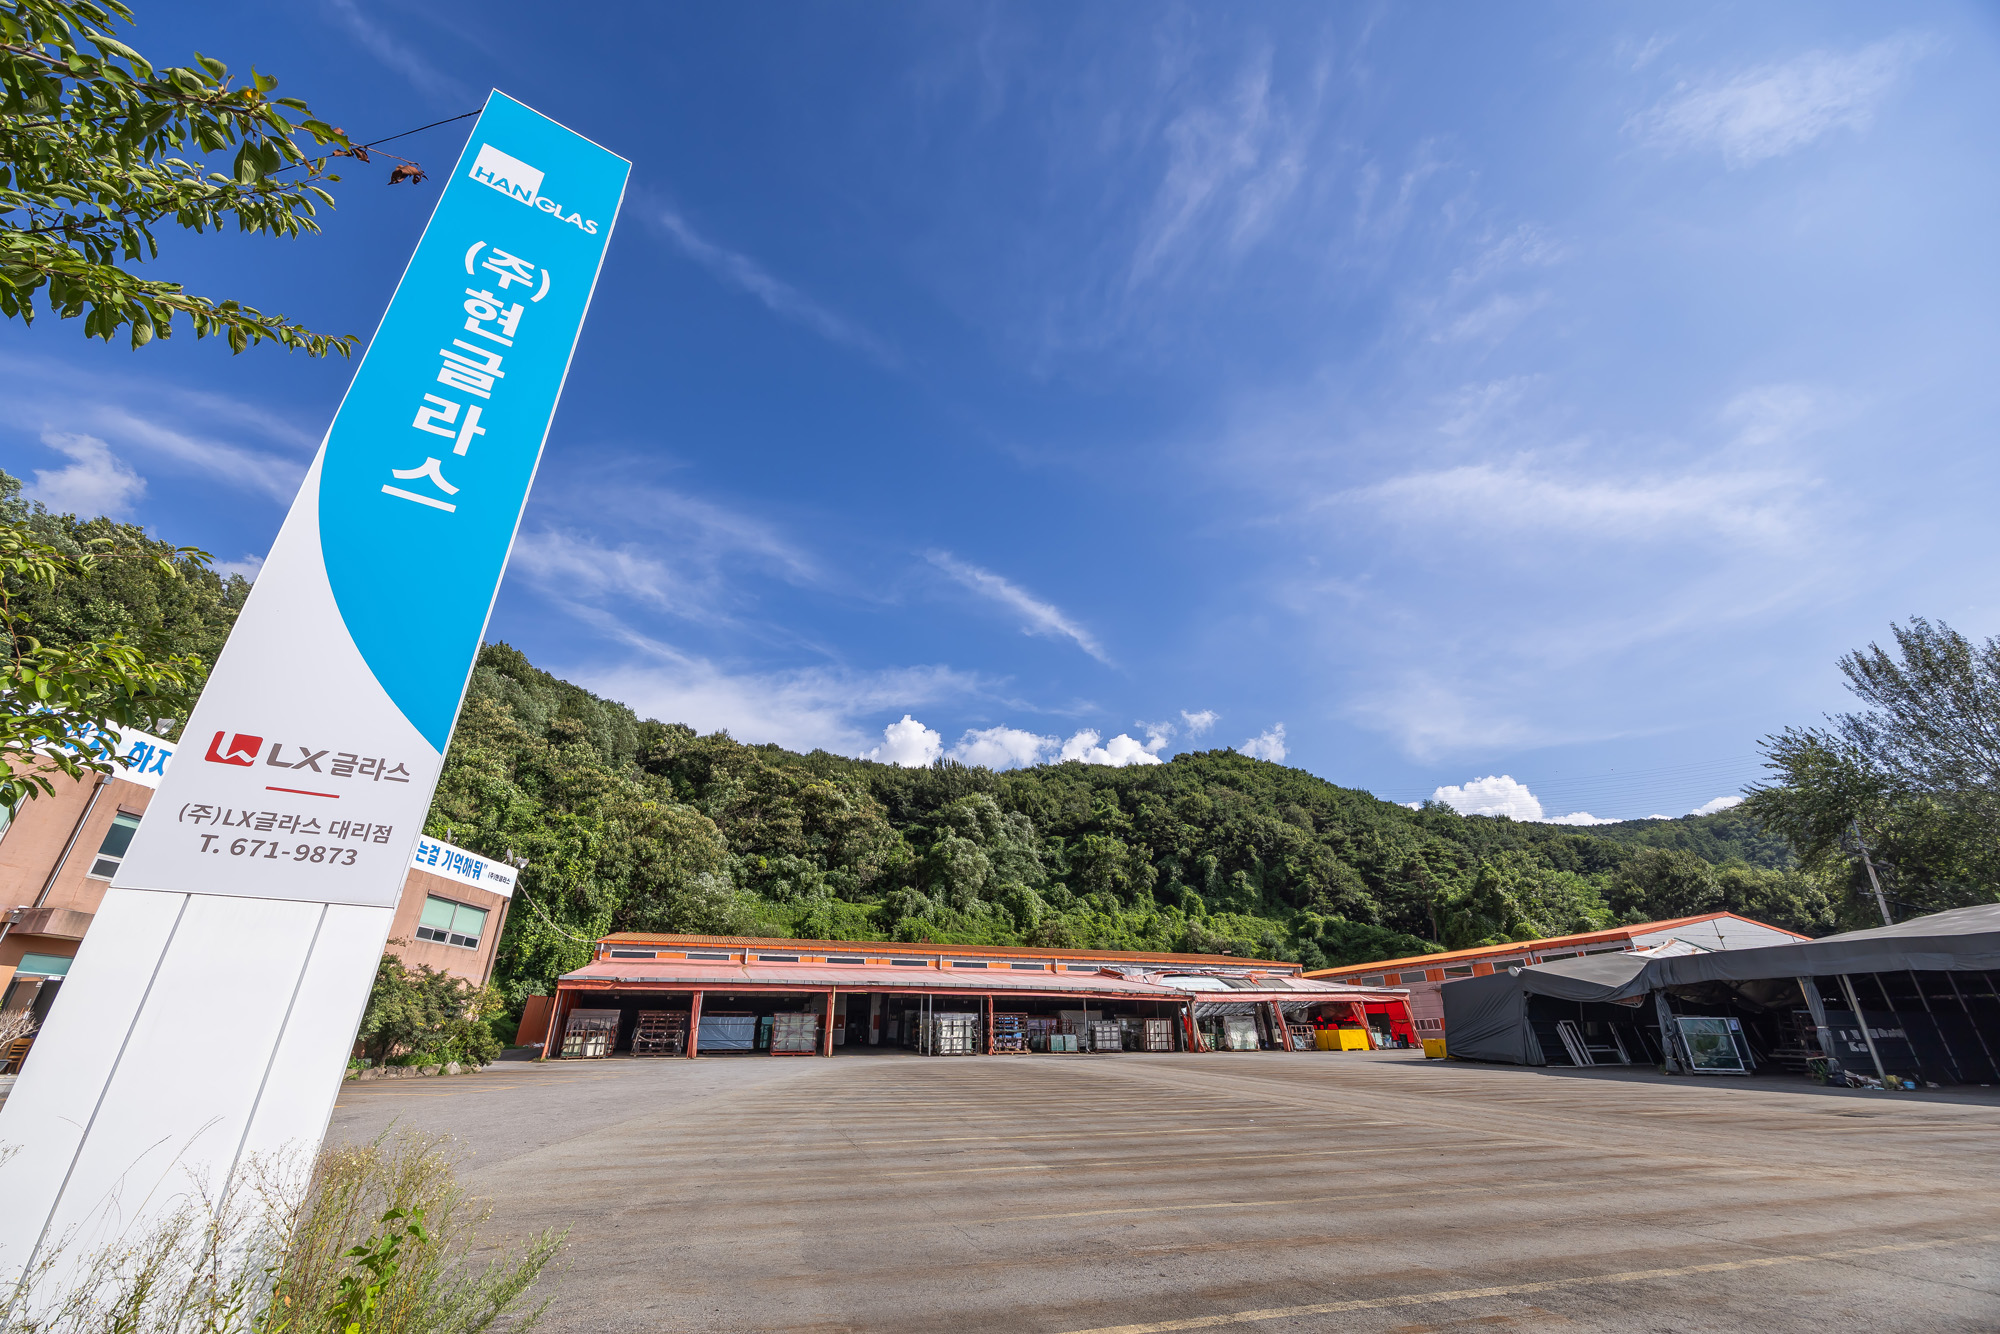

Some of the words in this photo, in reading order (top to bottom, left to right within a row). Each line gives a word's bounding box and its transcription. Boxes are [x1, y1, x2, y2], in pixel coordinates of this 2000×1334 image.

[475, 166, 598, 234] HANGLAS
[381, 240, 551, 513] (주)현글라스
[178, 802, 321, 835] (주)LX글라스
[328, 821, 393, 844] 대리점
[200, 833, 219, 854] T.
[230, 837, 358, 866] 671-9873
